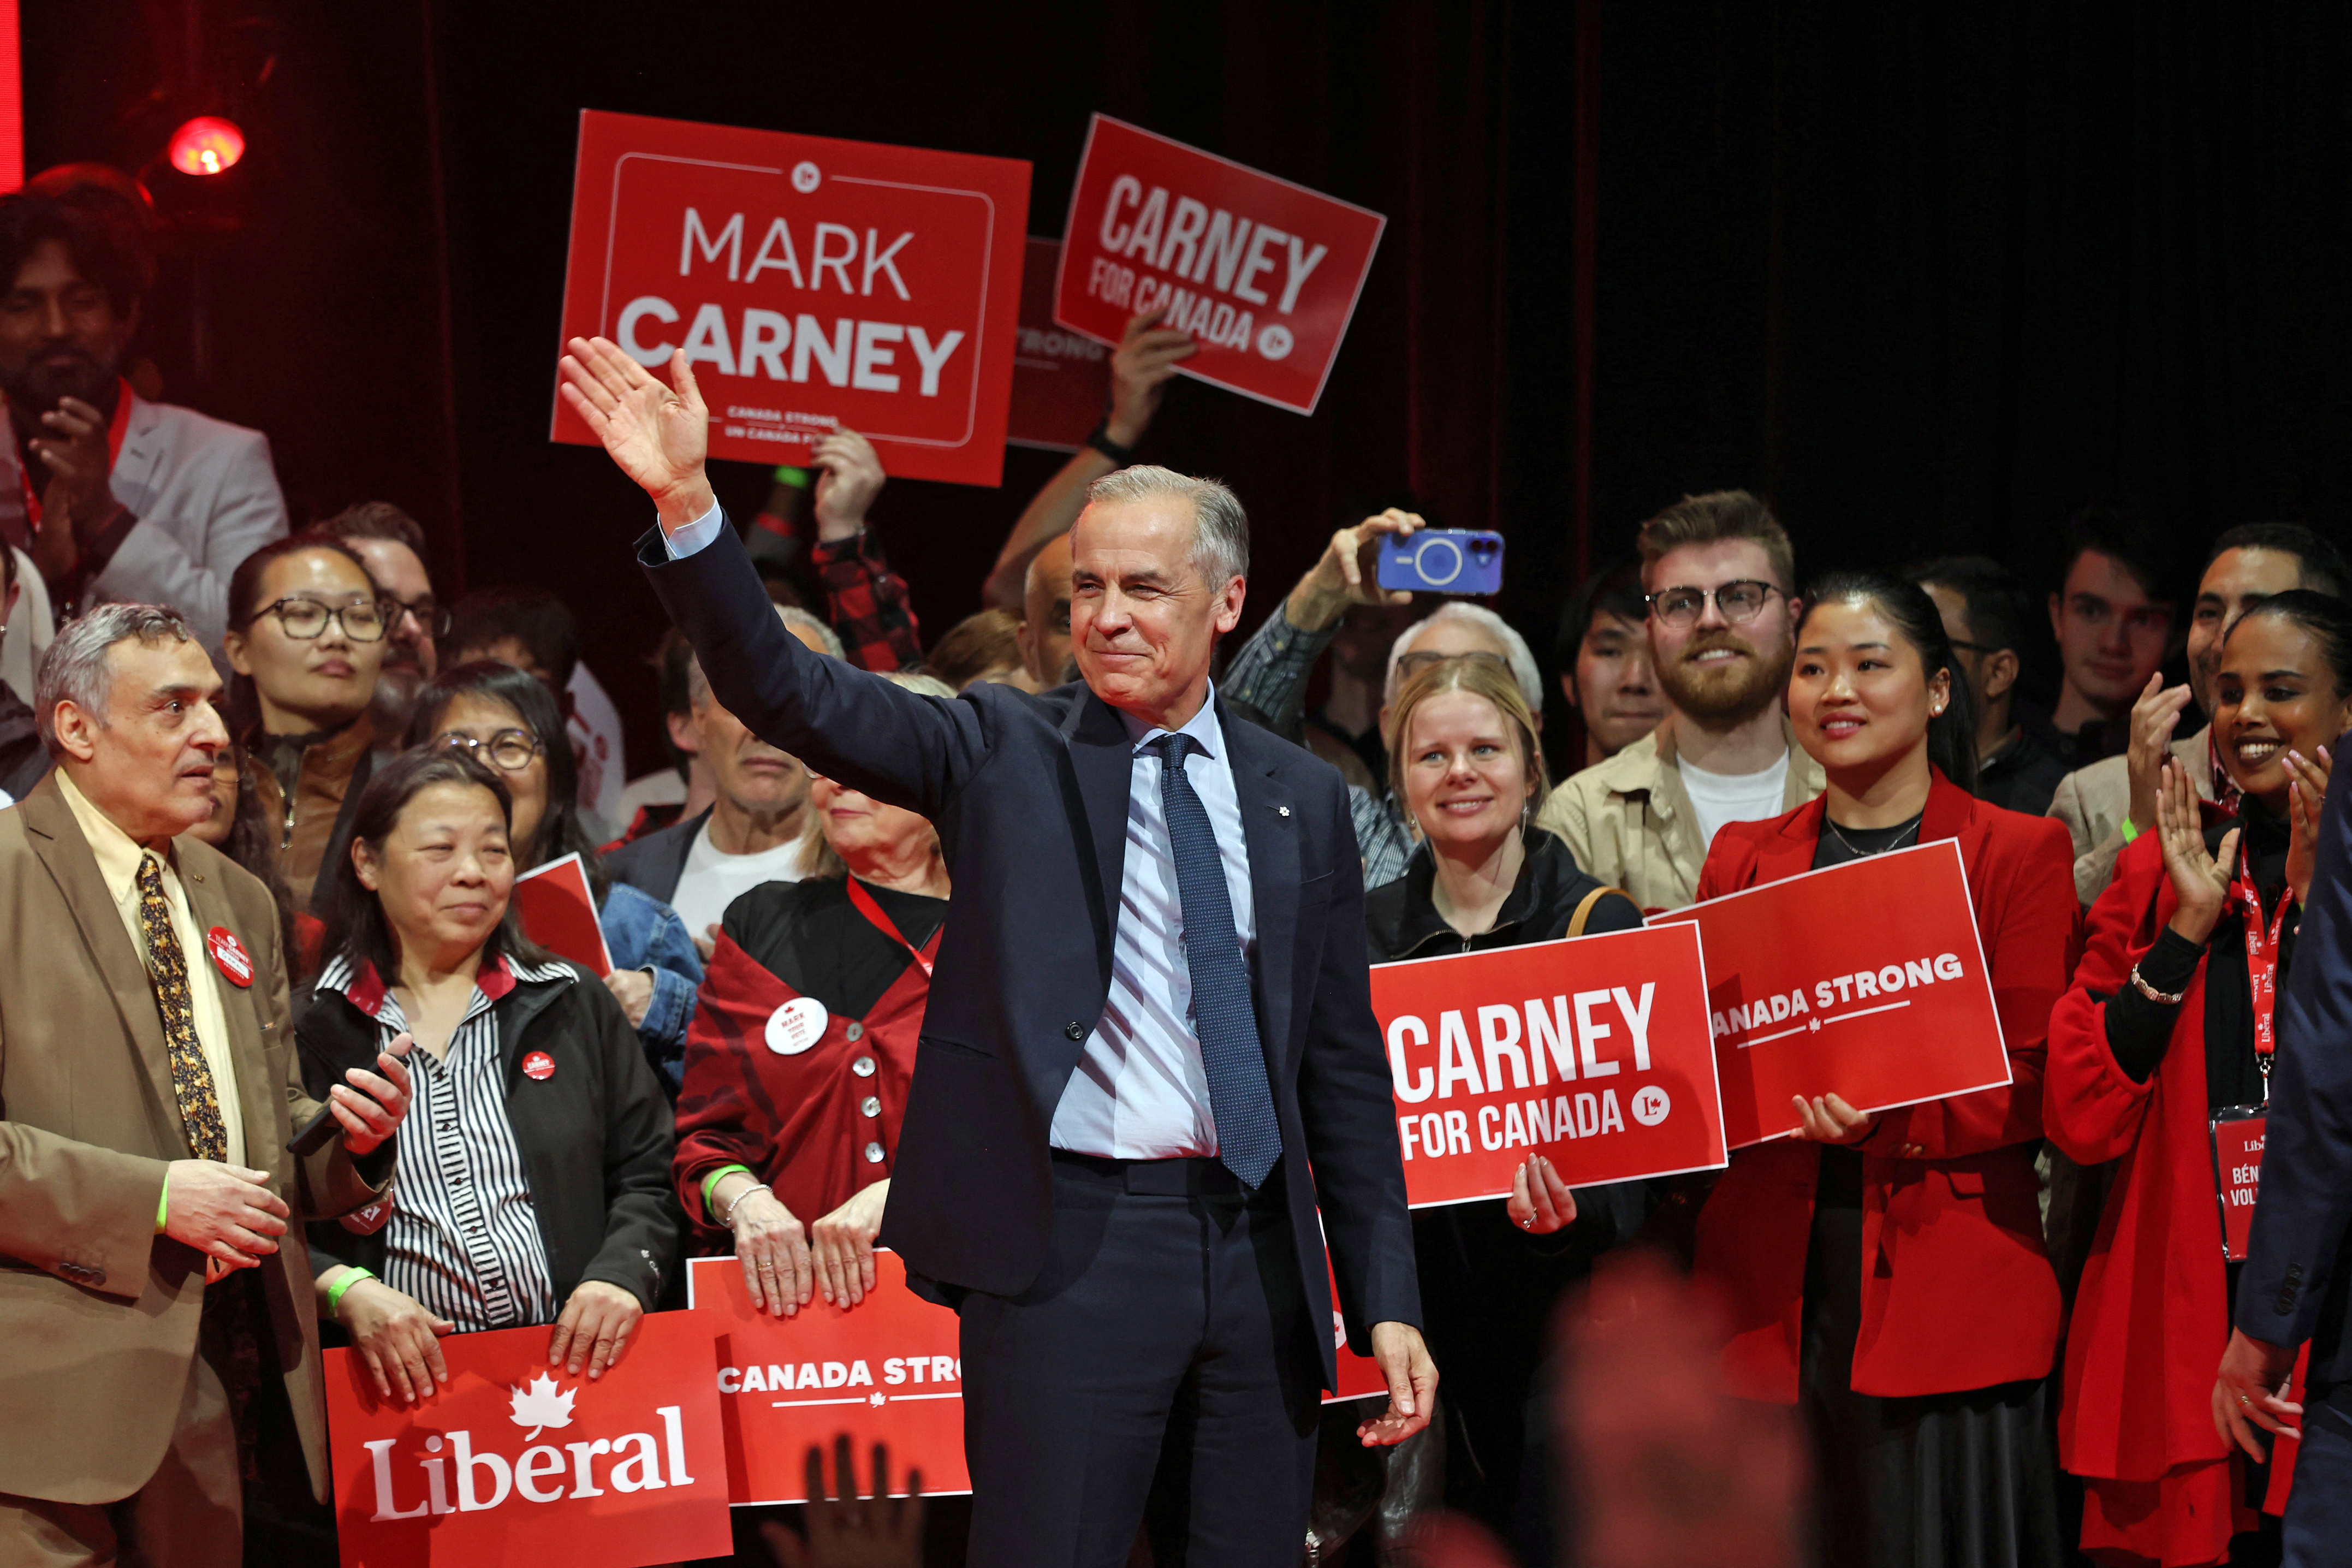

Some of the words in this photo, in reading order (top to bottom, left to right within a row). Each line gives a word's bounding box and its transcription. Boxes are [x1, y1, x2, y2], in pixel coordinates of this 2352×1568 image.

[680, 207, 914, 301] MARK
[1100, 175, 1328, 315] CARNEY
[1088, 257, 1136, 308] FOR
[1133, 276, 1254, 353] CANADA
[616, 295, 965, 397] CARNEY
[724, 425, 746, 437] UN
[746, 427, 800, 443] CANADA
[802, 432, 815, 444] P
[727, 405, 782, 421] CANADA
[785, 411, 839, 428] STRONG
[1713, 989, 1810, 1038] ANADA
[1815, 953, 1964, 1008] STRONG
[1387, 982, 1656, 1103] CARNEY
[1399, 1110, 1472, 1161] FOR
[1478, 1089, 1625, 1151] CANADA
[2230, 1187, 2258, 1207] VOL
[2232, 1163, 2259, 1185] BÉN
[718, 1359, 874, 1394] CANADA
[883, 1355, 962, 1385] STR
